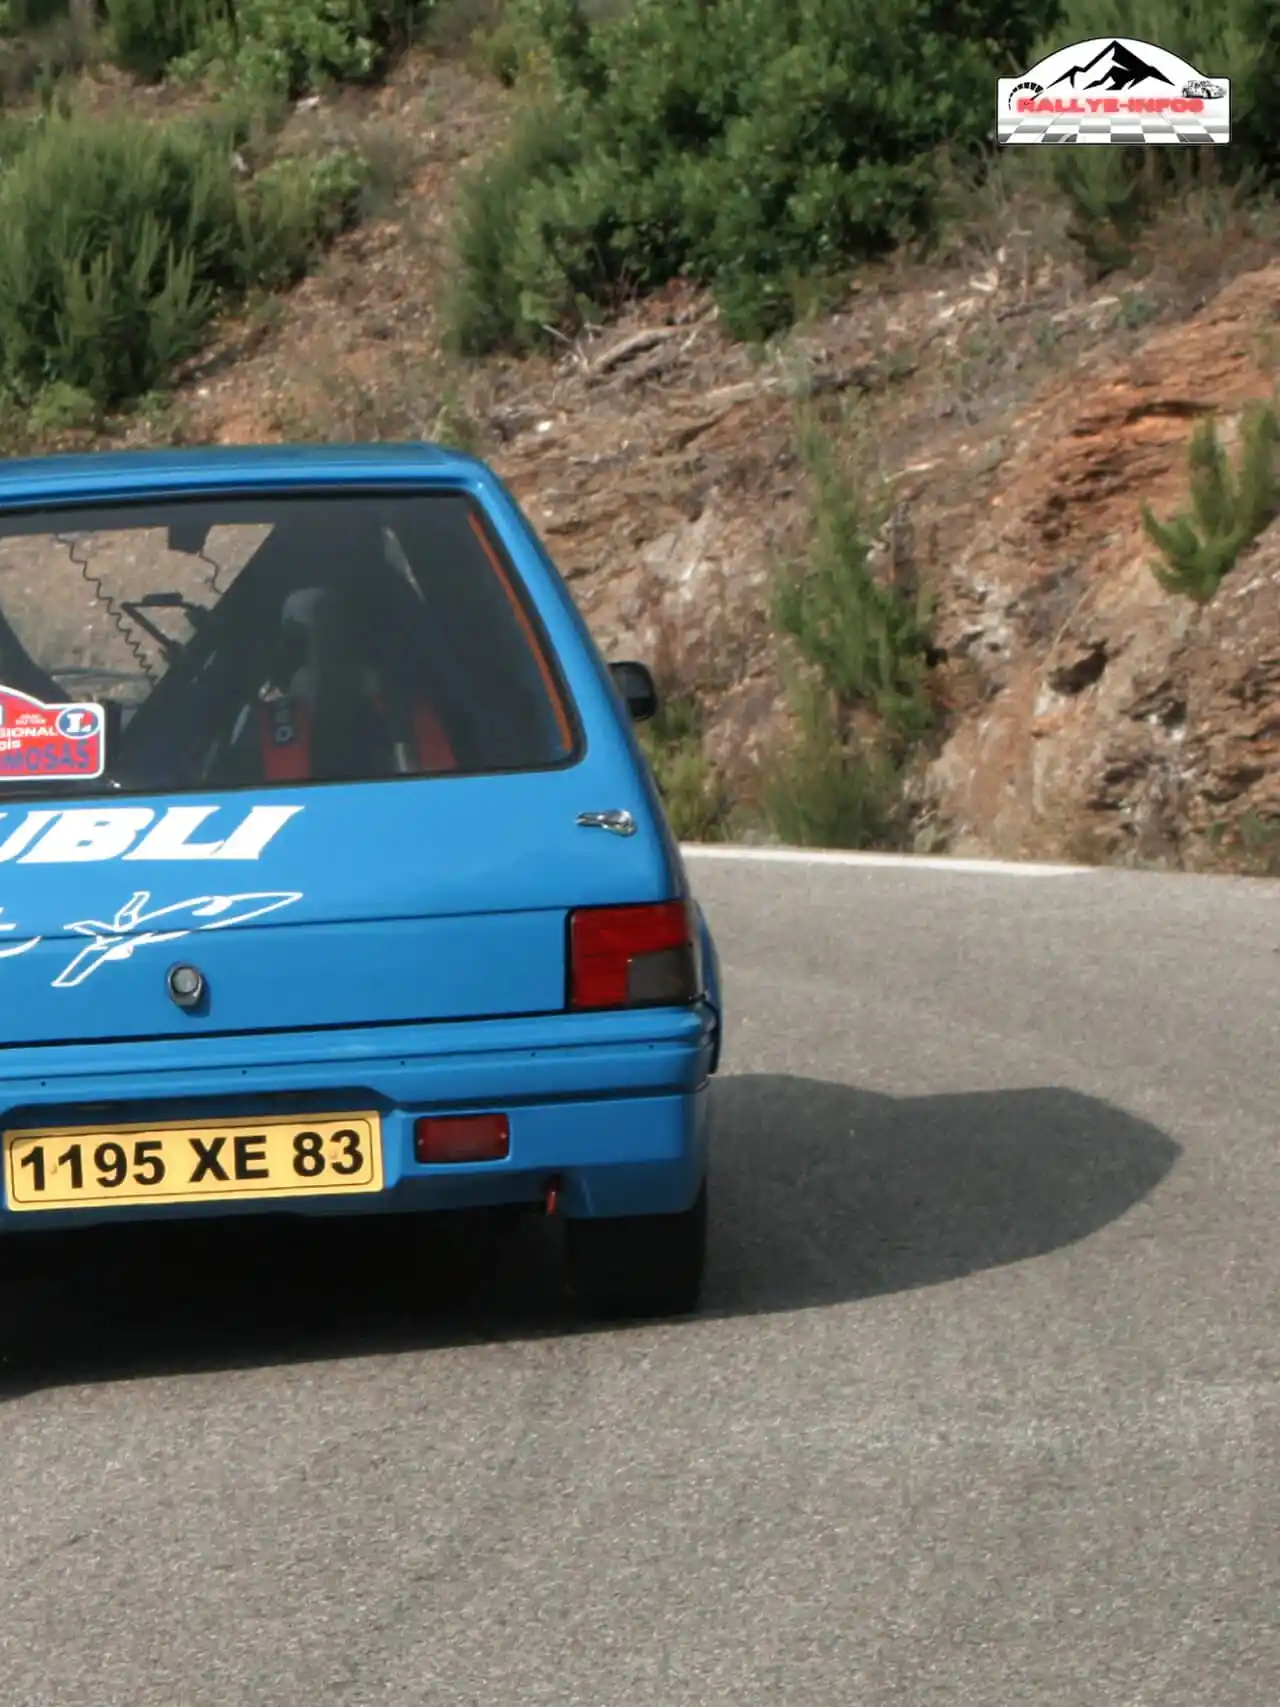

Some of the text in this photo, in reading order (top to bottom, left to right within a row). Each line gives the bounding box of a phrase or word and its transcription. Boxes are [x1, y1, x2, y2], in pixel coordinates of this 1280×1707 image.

[20, 1128, 365, 1192] 1195 XE 83
